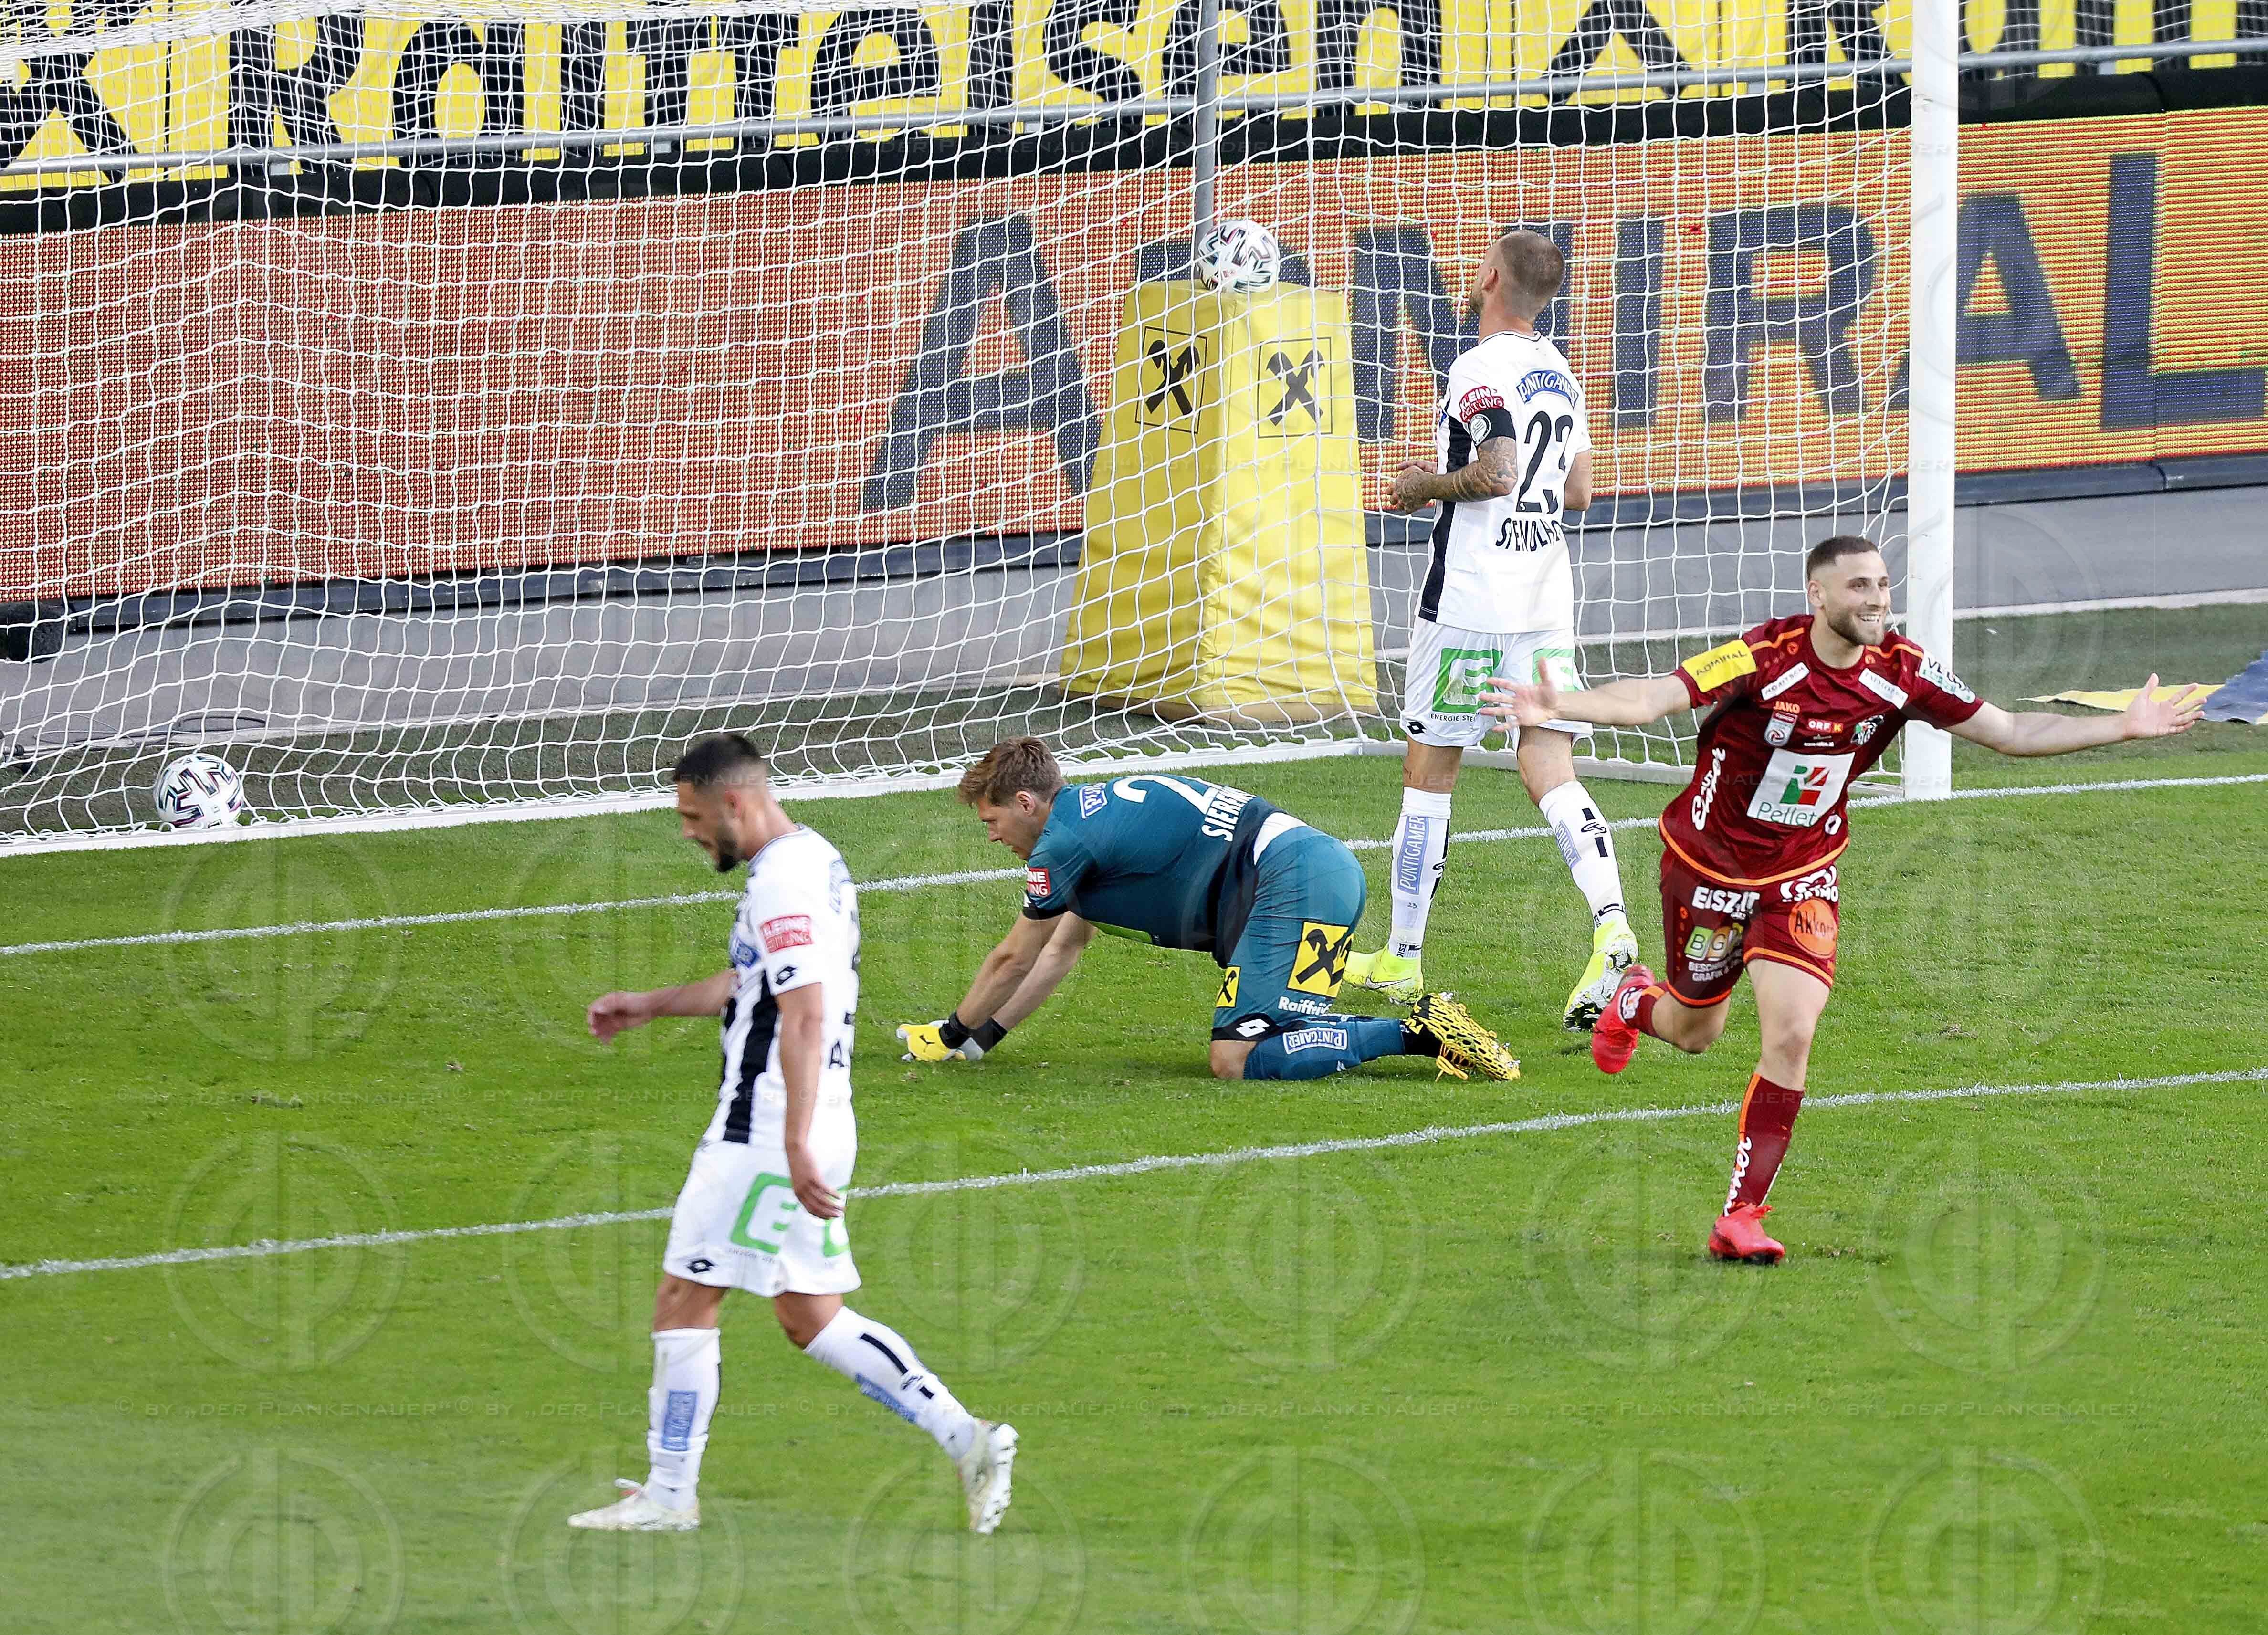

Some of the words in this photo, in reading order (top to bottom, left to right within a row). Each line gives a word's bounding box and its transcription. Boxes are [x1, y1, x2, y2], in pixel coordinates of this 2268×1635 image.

[861, 152, 2266, 519] AMIRAL
[1459, 387, 1497, 413] KLEIN
[1774, 701, 1800, 714] JAKO
[1430, 713, 1459, 722] ENERGIE
[1808, 720, 1832, 731] ORF
[1399, 816, 1427, 891] PUNTIGAMER
